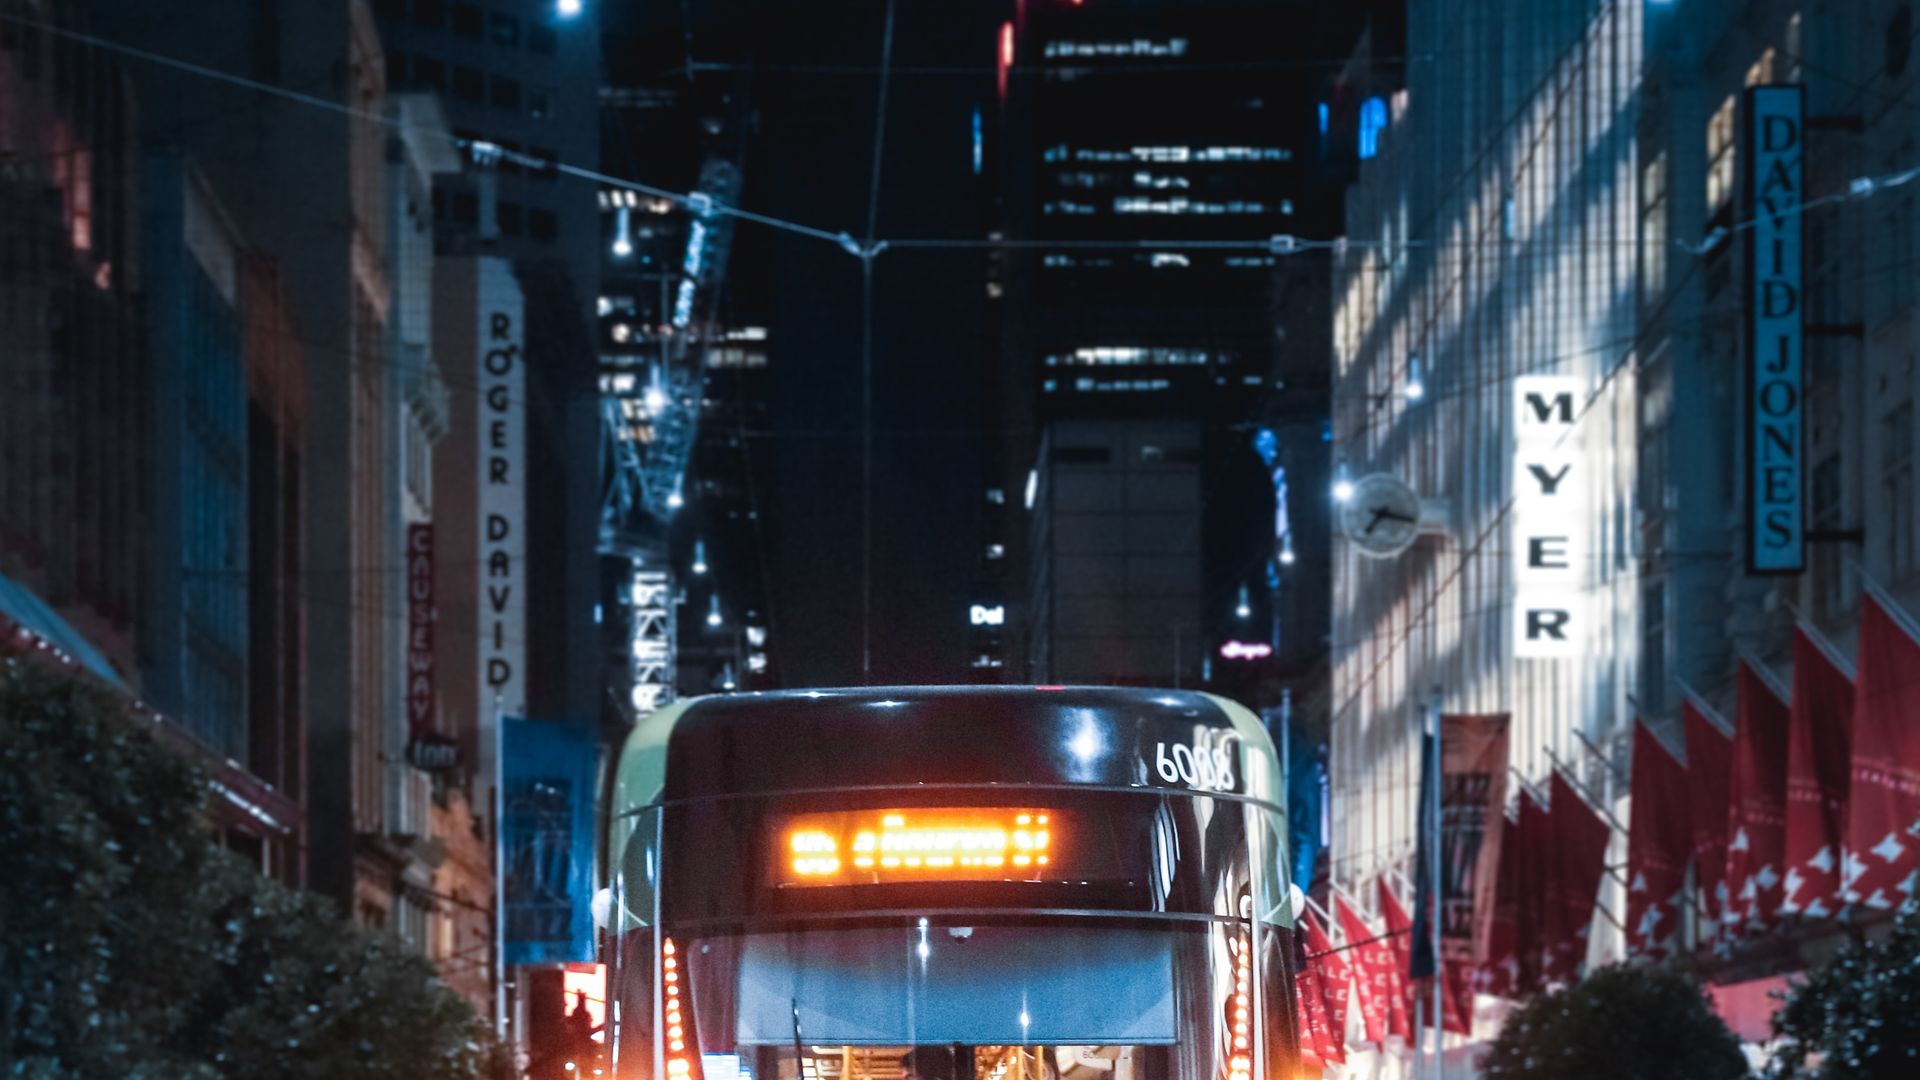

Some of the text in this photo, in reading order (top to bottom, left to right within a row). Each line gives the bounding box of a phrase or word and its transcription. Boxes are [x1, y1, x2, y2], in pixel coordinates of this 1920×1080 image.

[1760, 116, 1797, 548] DAVID JONES
[411, 530, 433, 719] CAUSEWAY
[485, 313, 512, 686] ROGER DAVID
[1524, 392, 1575, 640] MYER
